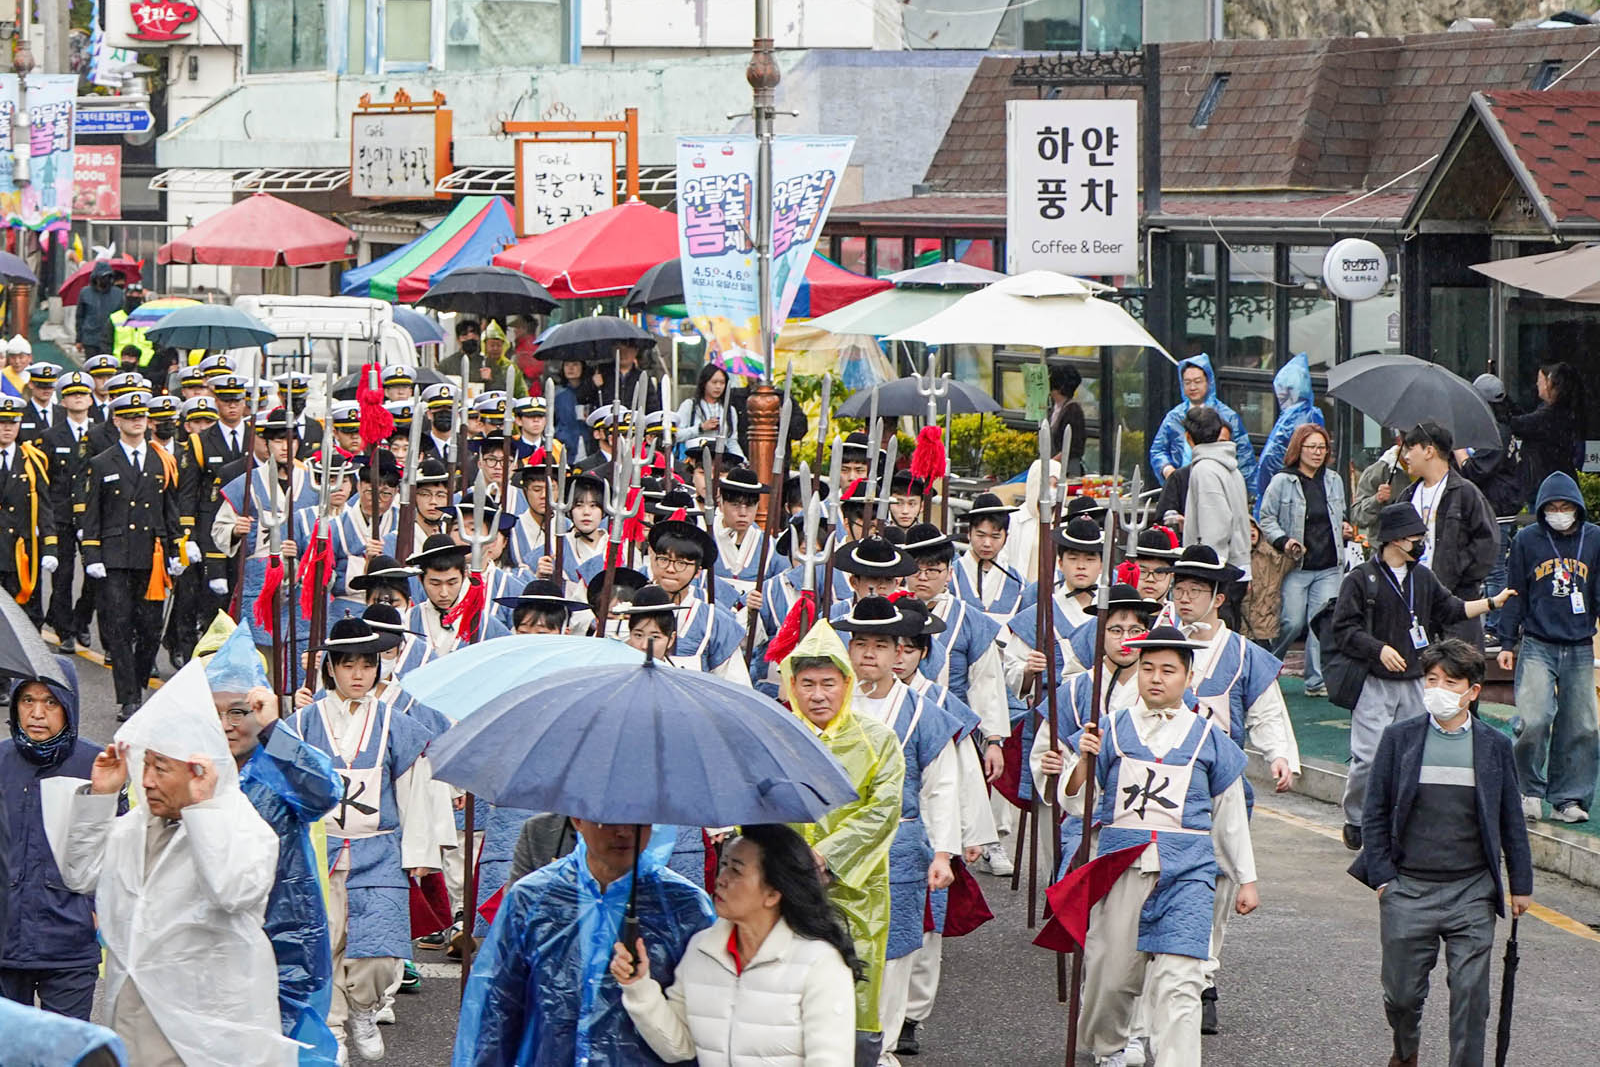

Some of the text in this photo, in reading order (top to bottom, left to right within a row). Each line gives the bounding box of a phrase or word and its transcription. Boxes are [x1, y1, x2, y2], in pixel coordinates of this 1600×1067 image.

[1036, 125, 1120, 167] 하얀
[535, 172, 604, 198] 복숭아꽃
[682, 171, 750, 206] 유달산
[774, 169, 834, 207] 유달산
[1036, 176, 1119, 220] 풍차
[685, 188, 746, 257] 봄 축제
[774, 204, 799, 259] 봄
[1031, 239, 1124, 254] Coffee & Beer
[1341, 258, 1380, 272] 하얀풍차
[336, 777, 380, 829] 水
[1122, 767, 1179, 818] 水
